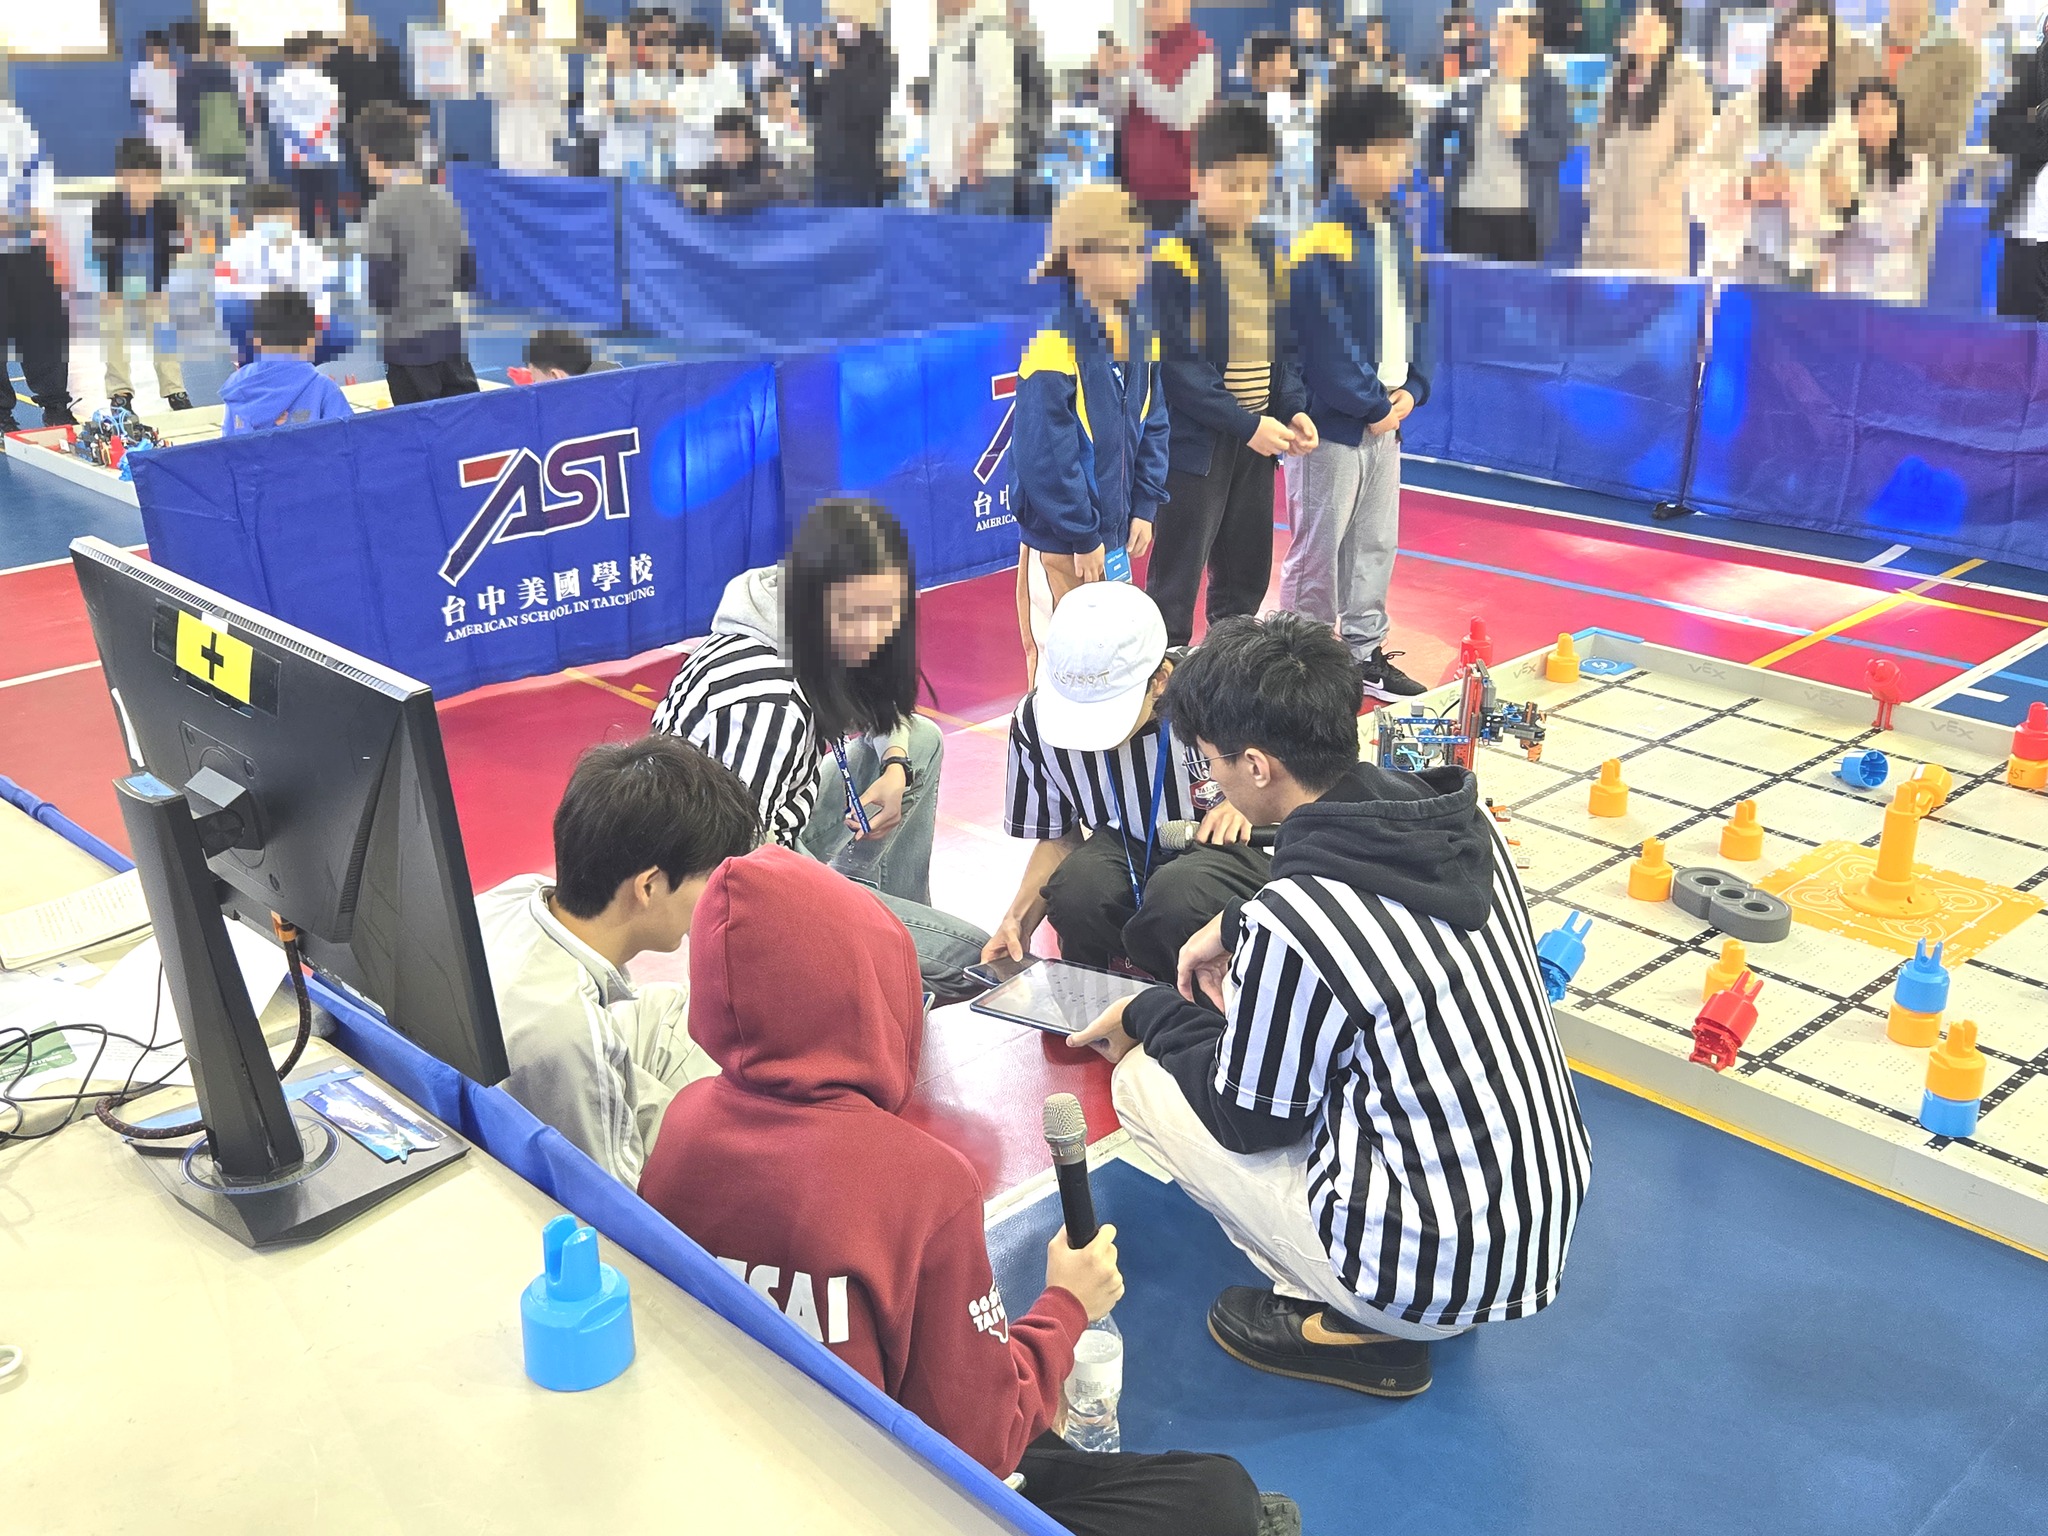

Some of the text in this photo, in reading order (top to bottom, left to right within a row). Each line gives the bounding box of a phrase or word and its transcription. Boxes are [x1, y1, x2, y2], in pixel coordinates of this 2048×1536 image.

[441, 553, 655, 627] 台中美國學校
[444, 586, 656, 643] AMERICAN SCHOOL IN TAICHUNG
[1687, 662, 1727, 681] VEX
[1929, 720, 1975, 740] VEX
[1379, 1377, 1397, 1388] AIR
